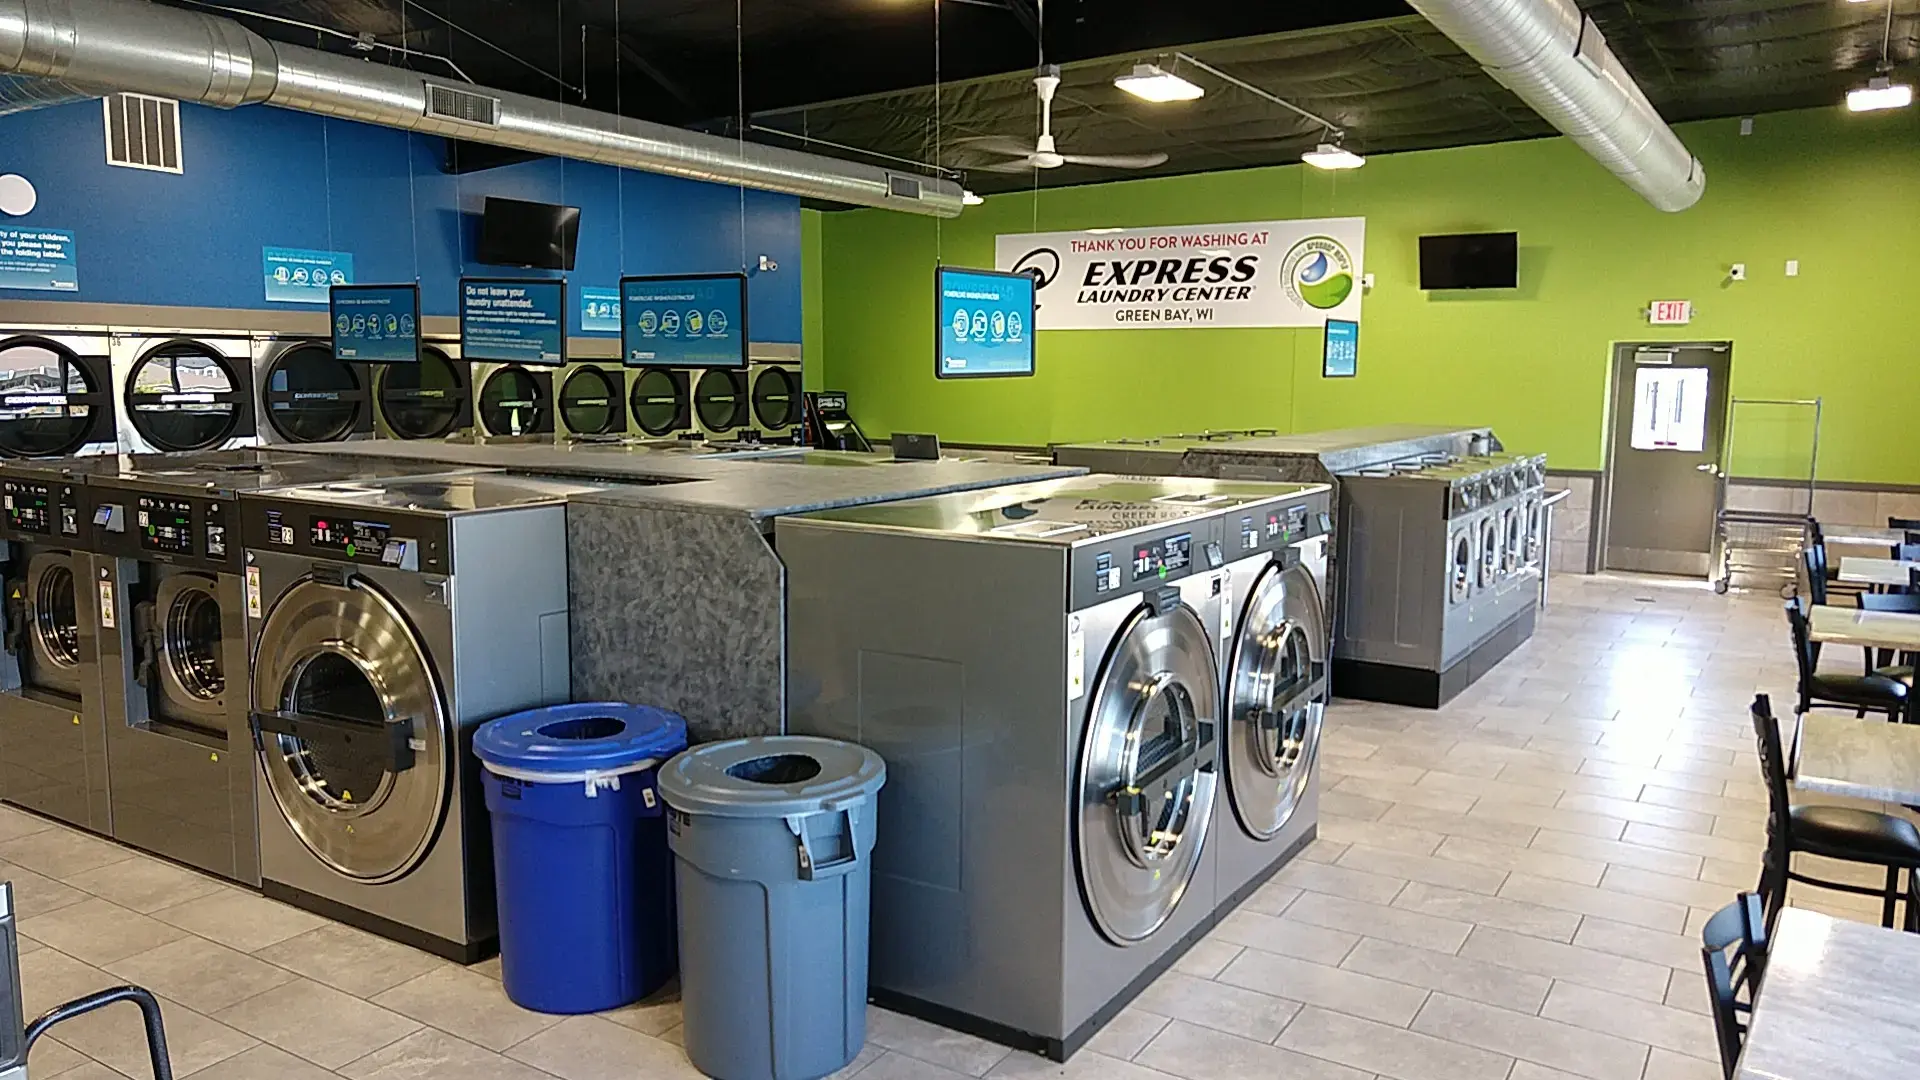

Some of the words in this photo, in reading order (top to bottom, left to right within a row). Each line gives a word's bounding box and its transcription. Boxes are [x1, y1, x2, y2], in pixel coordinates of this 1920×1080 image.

[17, 241, 42, 249] please
[43, 242, 62, 251] keep
[38, 233, 71, 243] children,
[1070, 240, 1115, 253] THANK
[1117, 238, 1146, 250] YOU
[1149, 236, 1177, 249] FOR
[1180, 233, 1248, 248] WASHING
[1250, 231, 1270, 245] AT
[0, 248, 14, 256] the
[15, 249, 42, 259] folding
[42, 251, 68, 260] tables.
[1082, 255, 1259, 286] EXPRESS
[466, 286, 476, 296] Do
[477, 287, 489, 296] not
[490, 287, 508, 296] leave
[509, 289, 526, 298] your
[1076, 288, 1170, 303] LAUNDRY
[1172, 286, 1249, 301] CENTER
[466, 298, 491, 308] laundry
[492, 299, 534, 308] unattended.
[1115, 308, 1161, 322] GREEN
[1164, 308, 1193, 323] BAY,
[1196, 307, 1214, 321] WI
[1657, 303, 1684, 320] EXIT
[282, 527, 293, 544] 23
